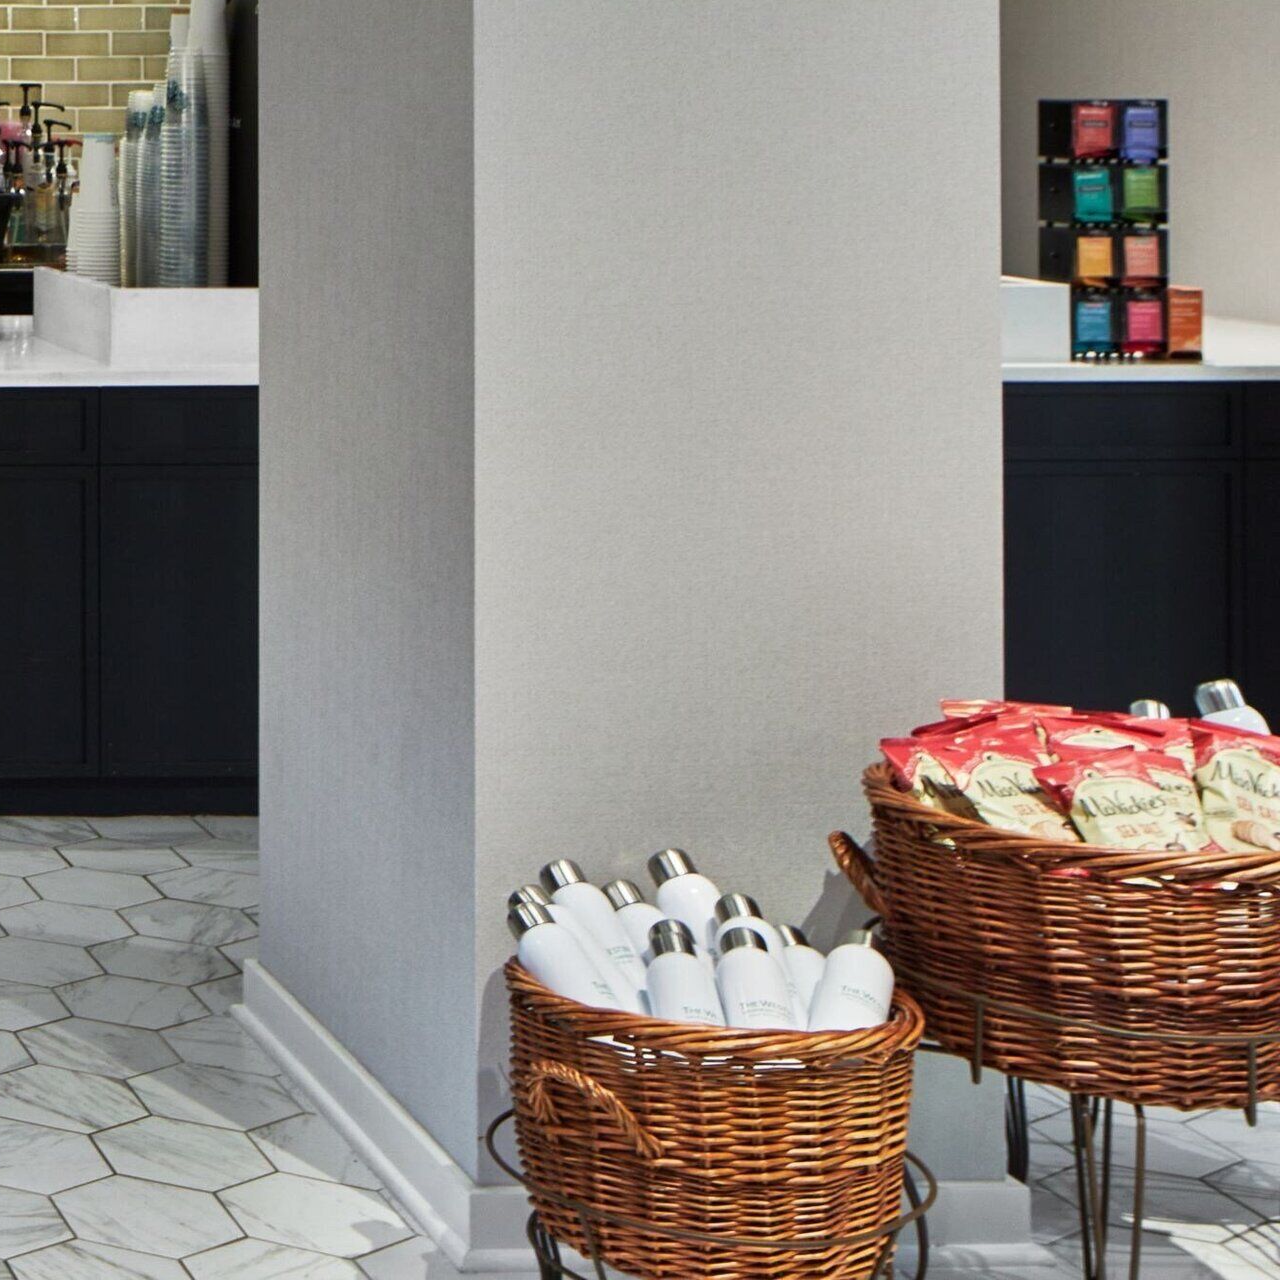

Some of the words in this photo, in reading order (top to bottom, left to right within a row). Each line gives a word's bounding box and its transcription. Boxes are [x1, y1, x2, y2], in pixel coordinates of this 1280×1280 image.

[1210, 760, 1252, 793] Miss
[976, 778, 1014, 799] Miss
[1078, 797, 1113, 821] Miss
[1114, 824, 1138, 839] SEA
[842, 984, 860, 996] THE
[683, 1006, 701, 1015] THE
[740, 1000, 758, 1010] THE
